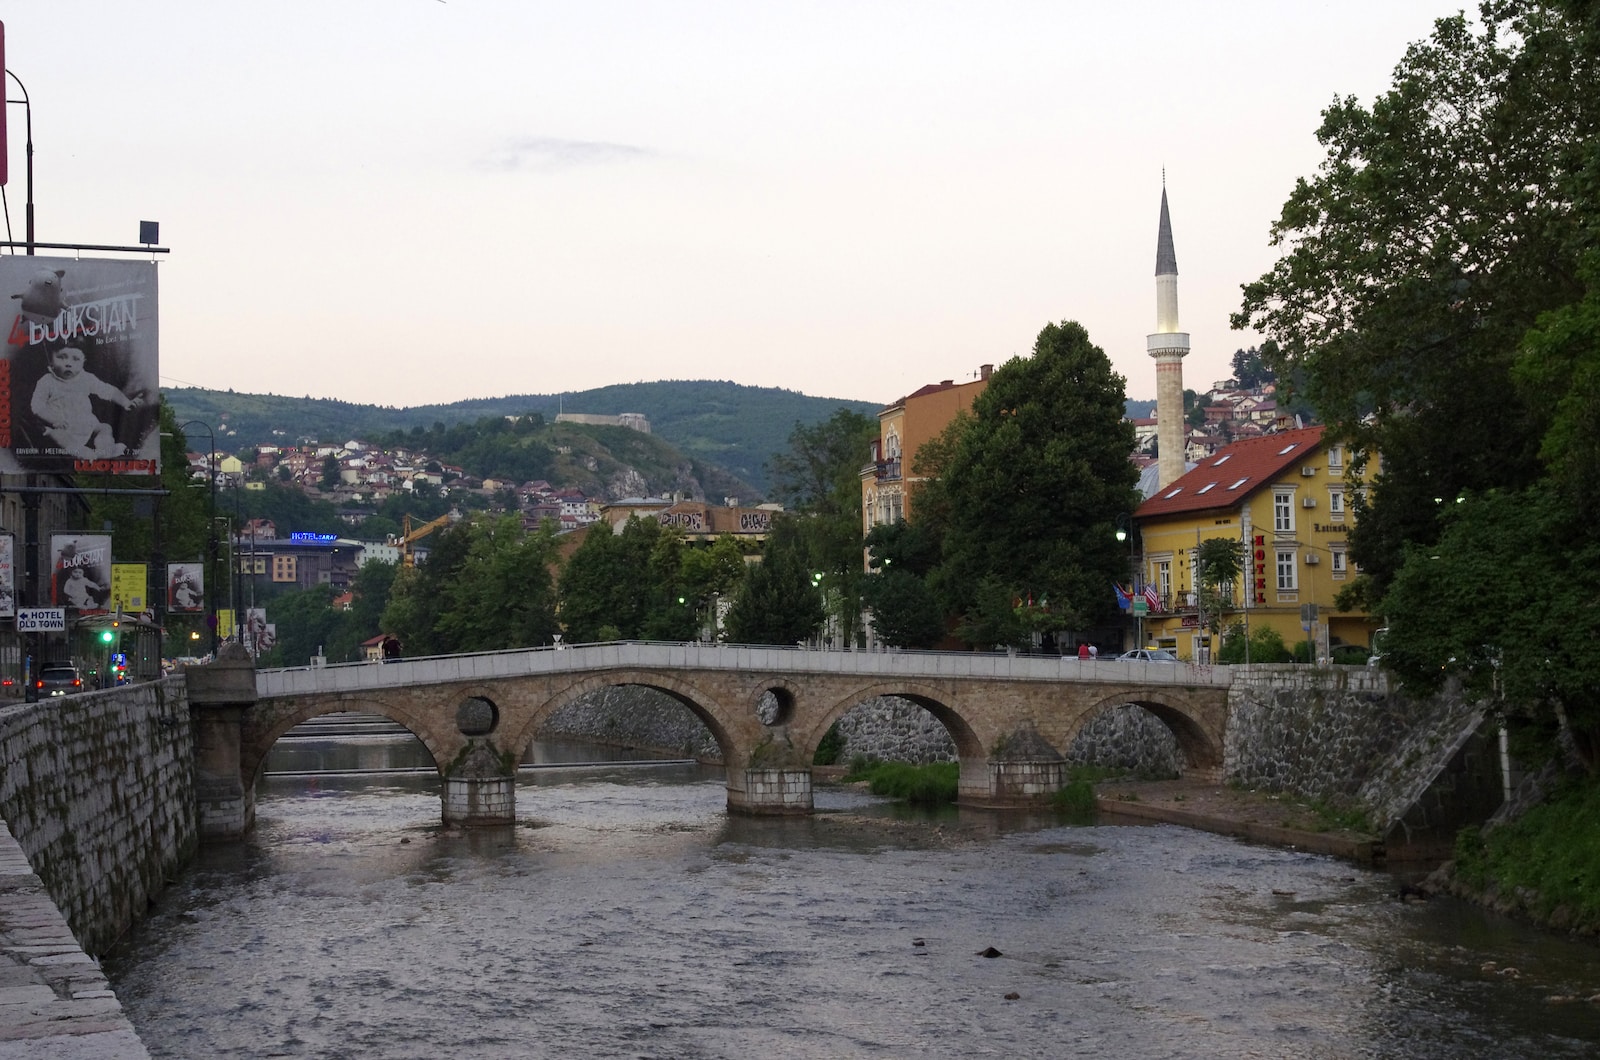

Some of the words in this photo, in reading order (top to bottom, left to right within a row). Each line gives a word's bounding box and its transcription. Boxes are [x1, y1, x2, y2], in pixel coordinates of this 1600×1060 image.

[291, 532, 318, 540] HOTEL
[1255, 535, 1266, 604] HOTEL
[31, 611, 62, 619] HOTEL
[19, 620, 36, 629] OLD
[38, 620, 64, 628] TOWN
